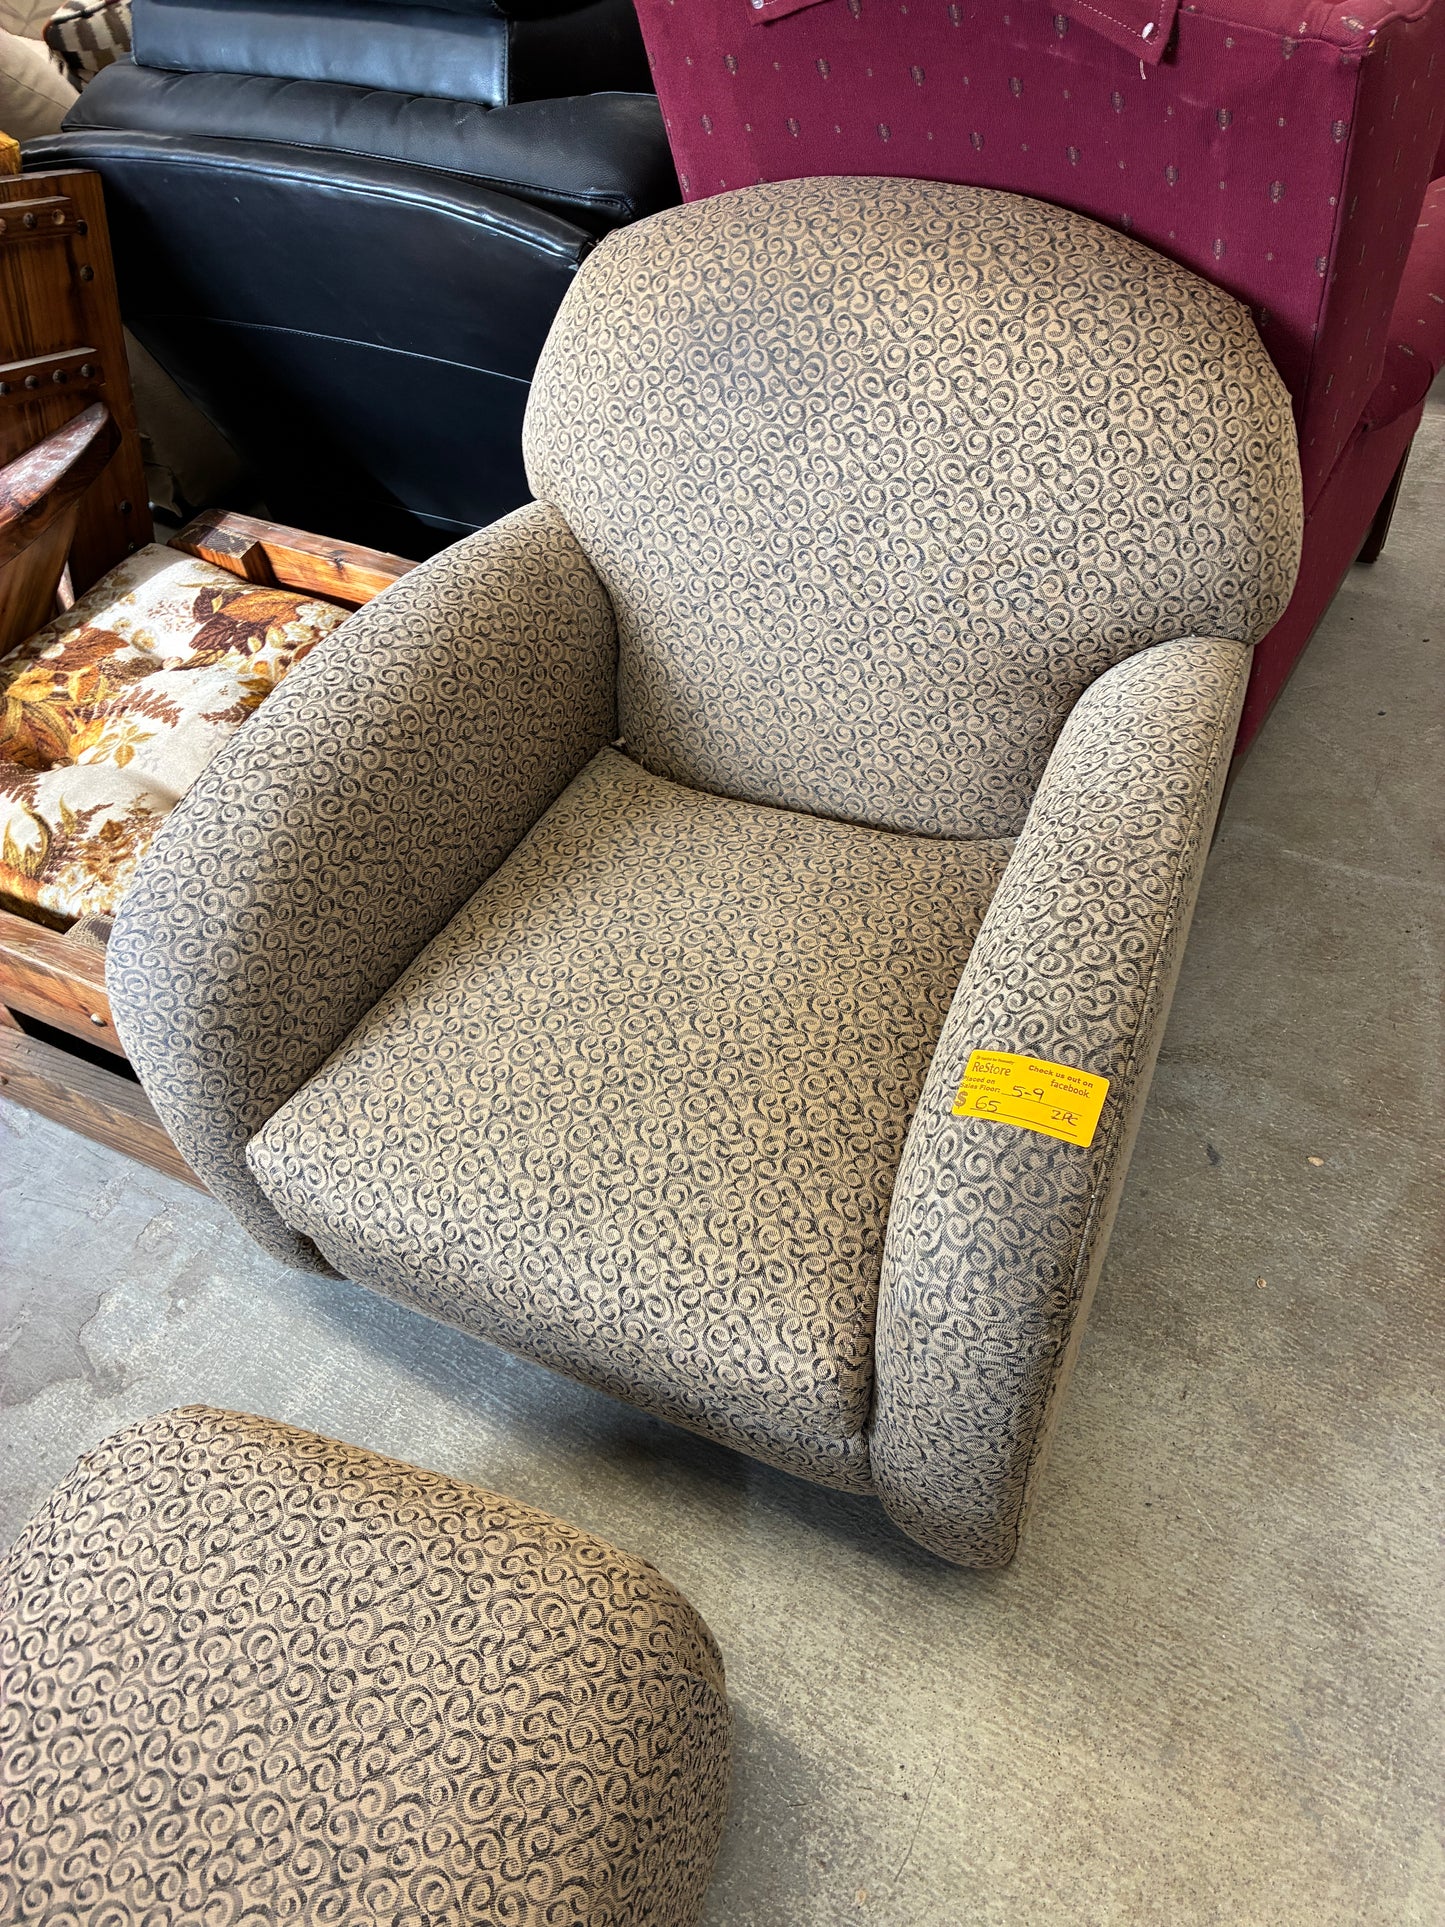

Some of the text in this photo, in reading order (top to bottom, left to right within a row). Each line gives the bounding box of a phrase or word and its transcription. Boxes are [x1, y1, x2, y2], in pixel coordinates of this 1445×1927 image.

[971, 1061, 1012, 1077] ReStore
[1028, 1064, 1054, 1076] Check
[1067, 1075, 1081, 1084] out
[1082, 1080, 1094, 1088] on
[979, 1084, 1001, 1093] Floor:
[954, 1091, 1002, 1113] $ 65
